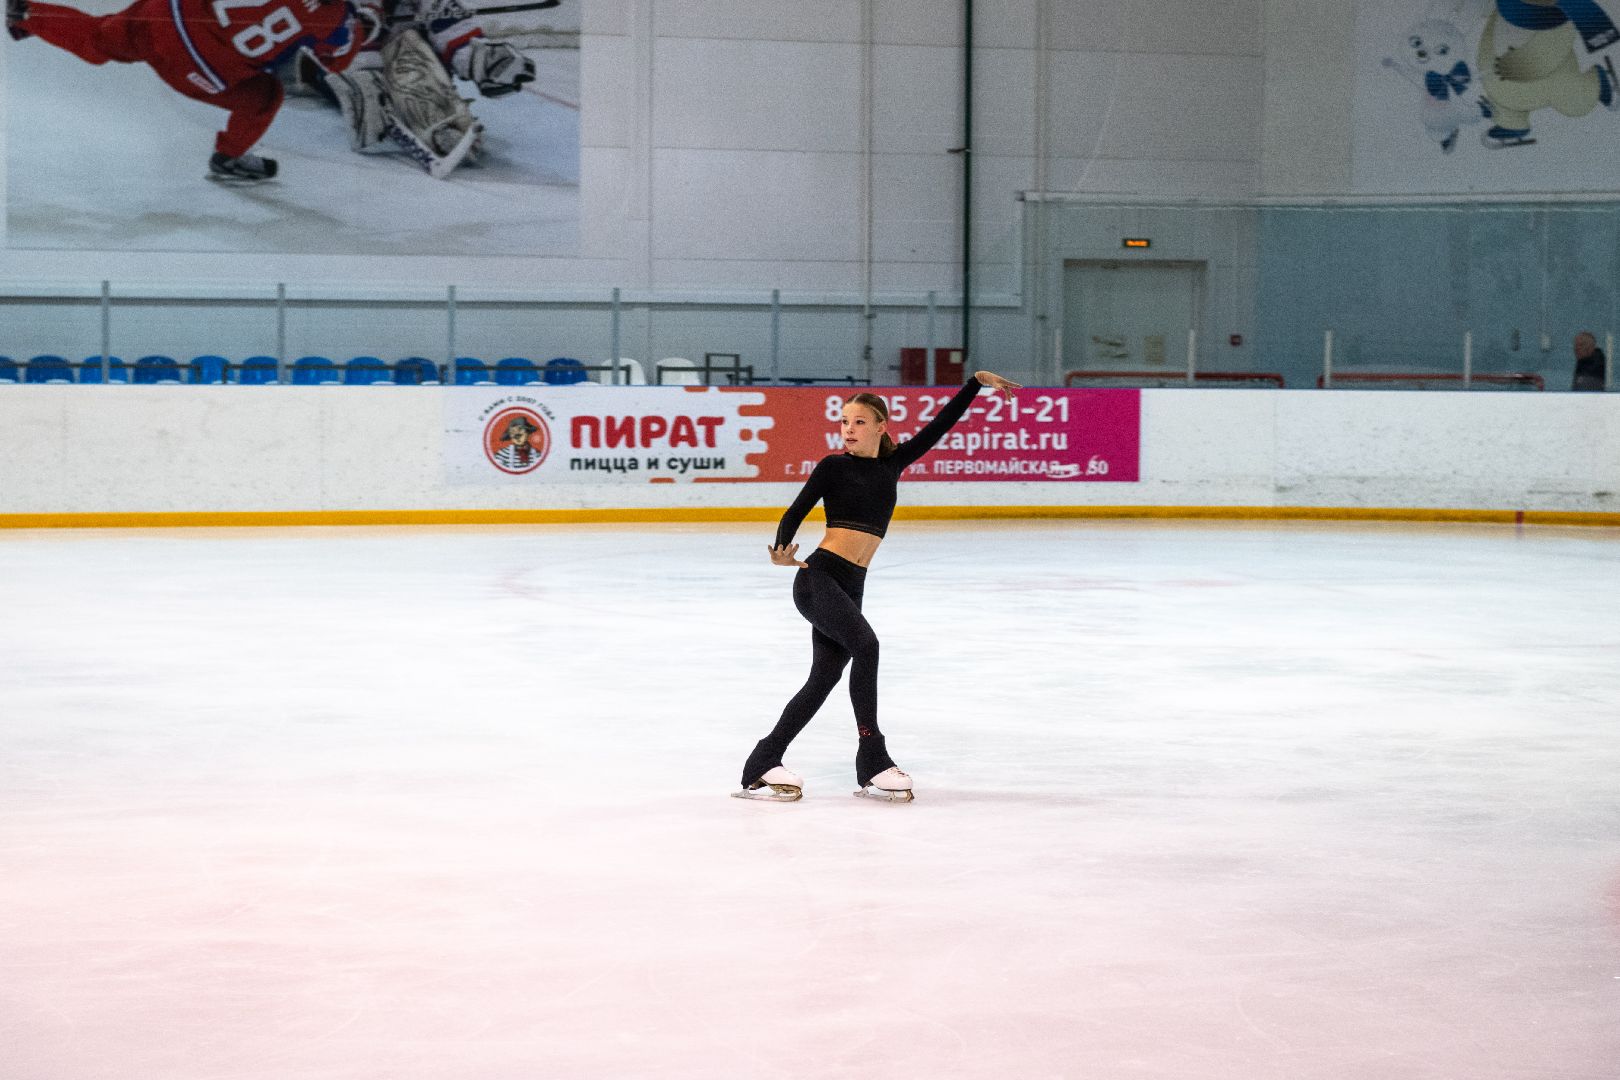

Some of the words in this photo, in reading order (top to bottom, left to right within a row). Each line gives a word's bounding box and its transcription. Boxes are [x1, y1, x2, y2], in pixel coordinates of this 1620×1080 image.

[570, 415, 725, 449] ПИРАТ
[570, 457, 639, 474] пицца
[647, 457, 659, 470] и
[666, 457, 725, 474] суши
